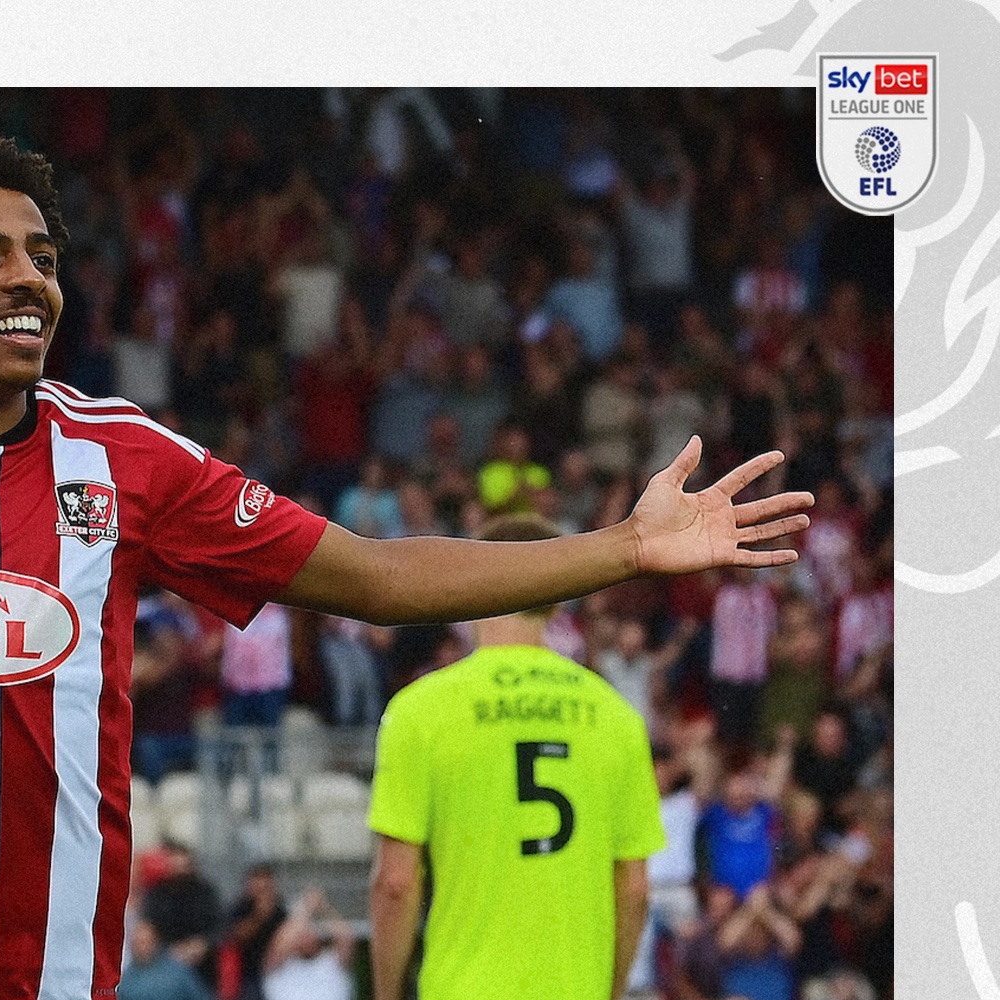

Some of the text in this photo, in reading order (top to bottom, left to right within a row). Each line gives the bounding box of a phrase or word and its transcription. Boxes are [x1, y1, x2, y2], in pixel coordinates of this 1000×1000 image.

[245, 484, 269, 512] Bidfo
[58, 525, 116, 538] EXETER CITY FC
[516, 741, 575, 856] 5
